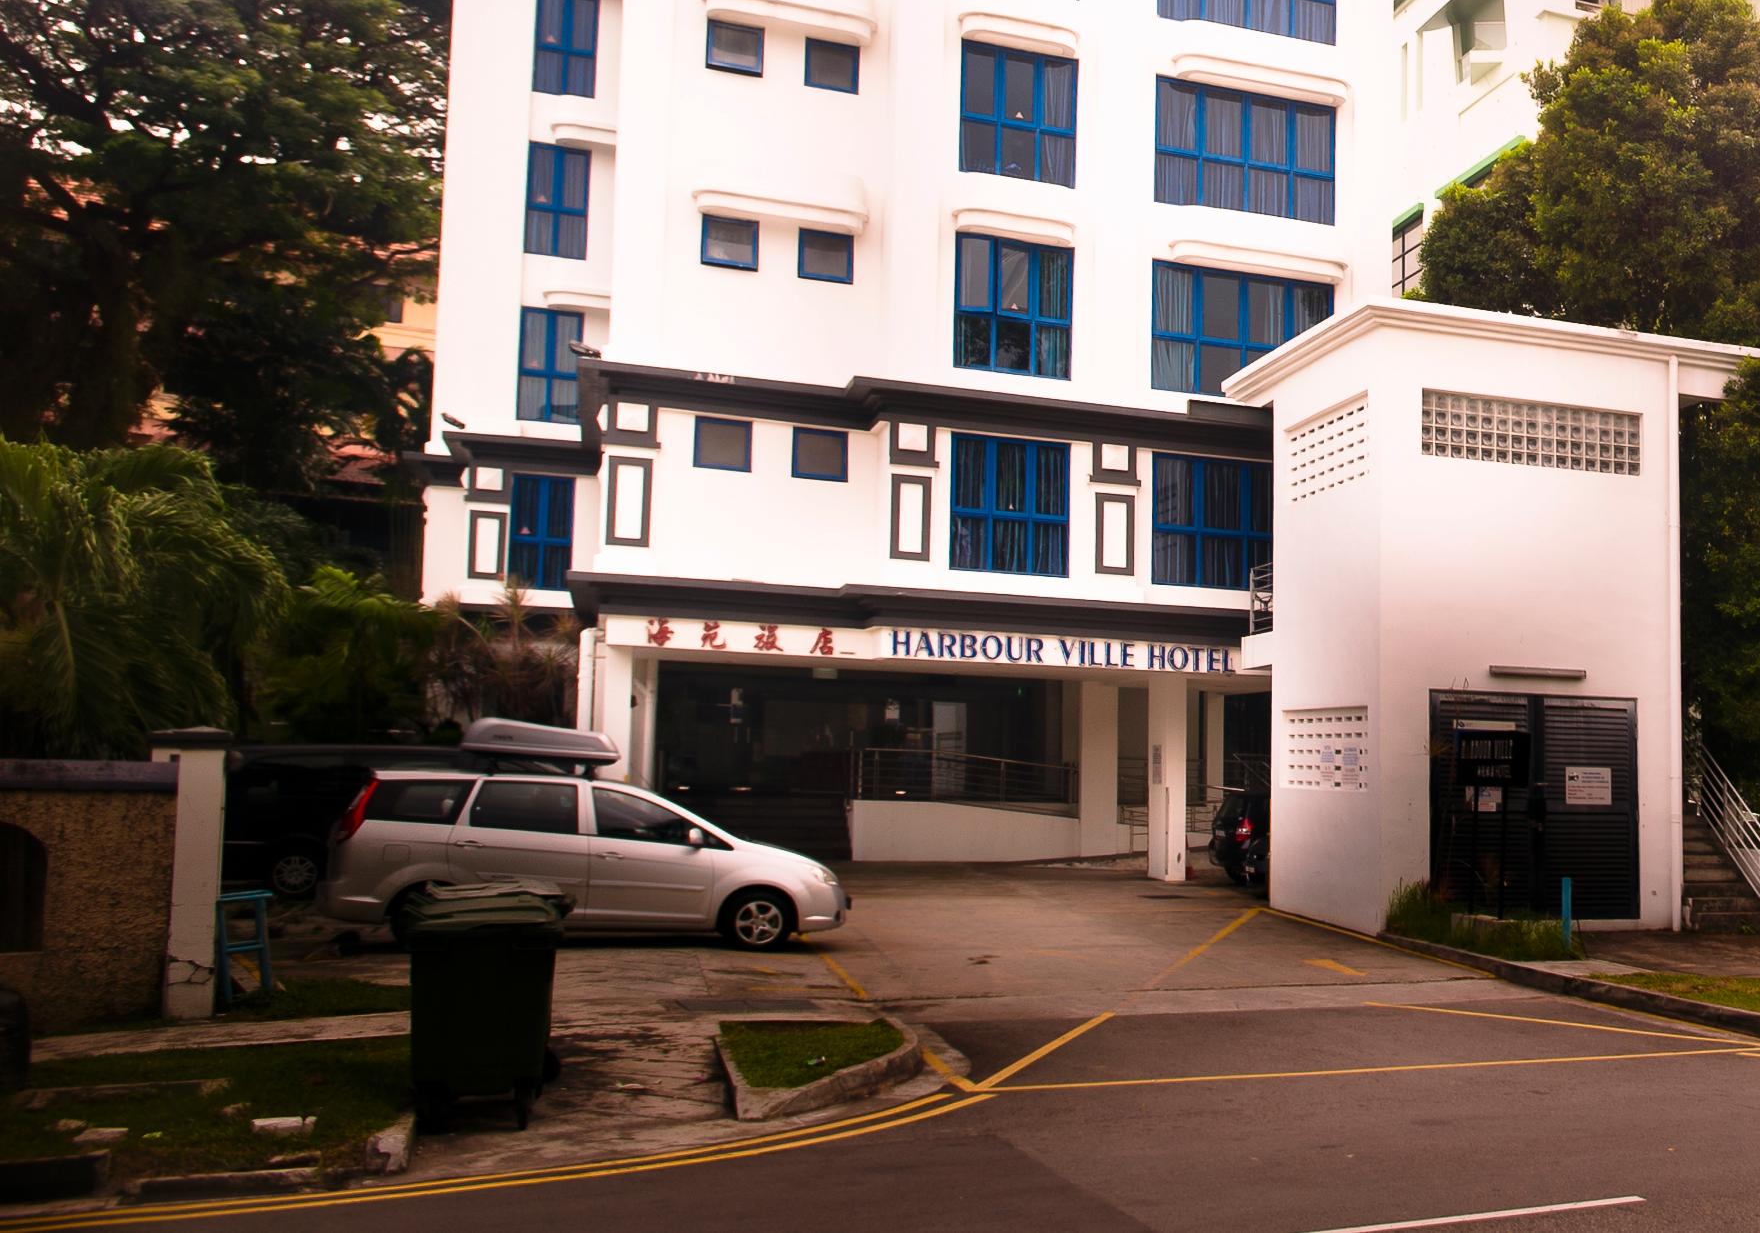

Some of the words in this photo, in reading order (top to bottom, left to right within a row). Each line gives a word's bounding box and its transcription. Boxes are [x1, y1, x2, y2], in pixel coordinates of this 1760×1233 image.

[890, 629, 1044, 664] HARBOUR
[1058, 638, 1135, 668] VILLE
[1146, 643, 1236, 674] HOTEL
